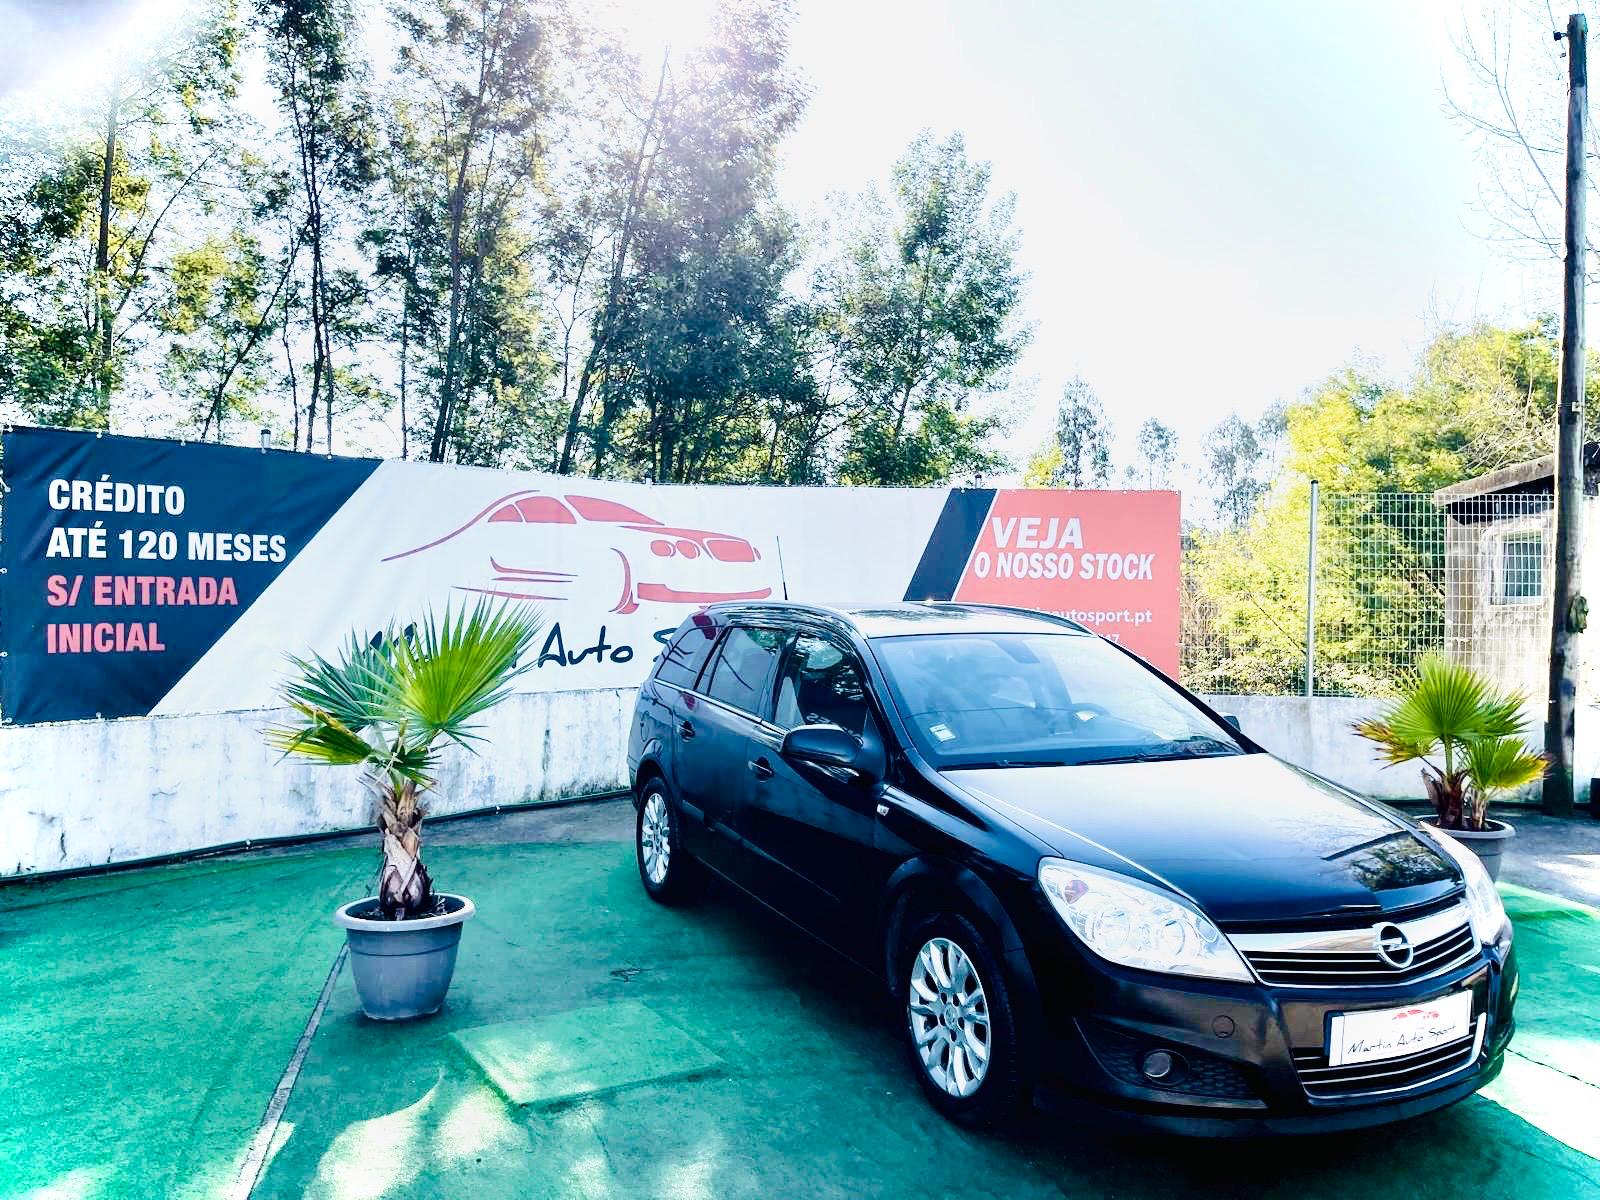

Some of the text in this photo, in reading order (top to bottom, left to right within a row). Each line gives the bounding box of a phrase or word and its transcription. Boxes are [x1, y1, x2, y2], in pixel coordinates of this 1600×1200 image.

[48, 474, 185, 515] CRÉDITO
[46, 521, 286, 562] ATÉ 120 MESES
[992, 517, 1083, 549] VEJA
[974, 552, 1155, 581] O NOSSO STOCK
[47, 575, 238, 607] S/ ENTRADA
[47, 622, 165, 654] INICIAL
[537, 622, 634, 669] Auto
[1347, 1022, 1456, 1054] Martin Auto Sport
